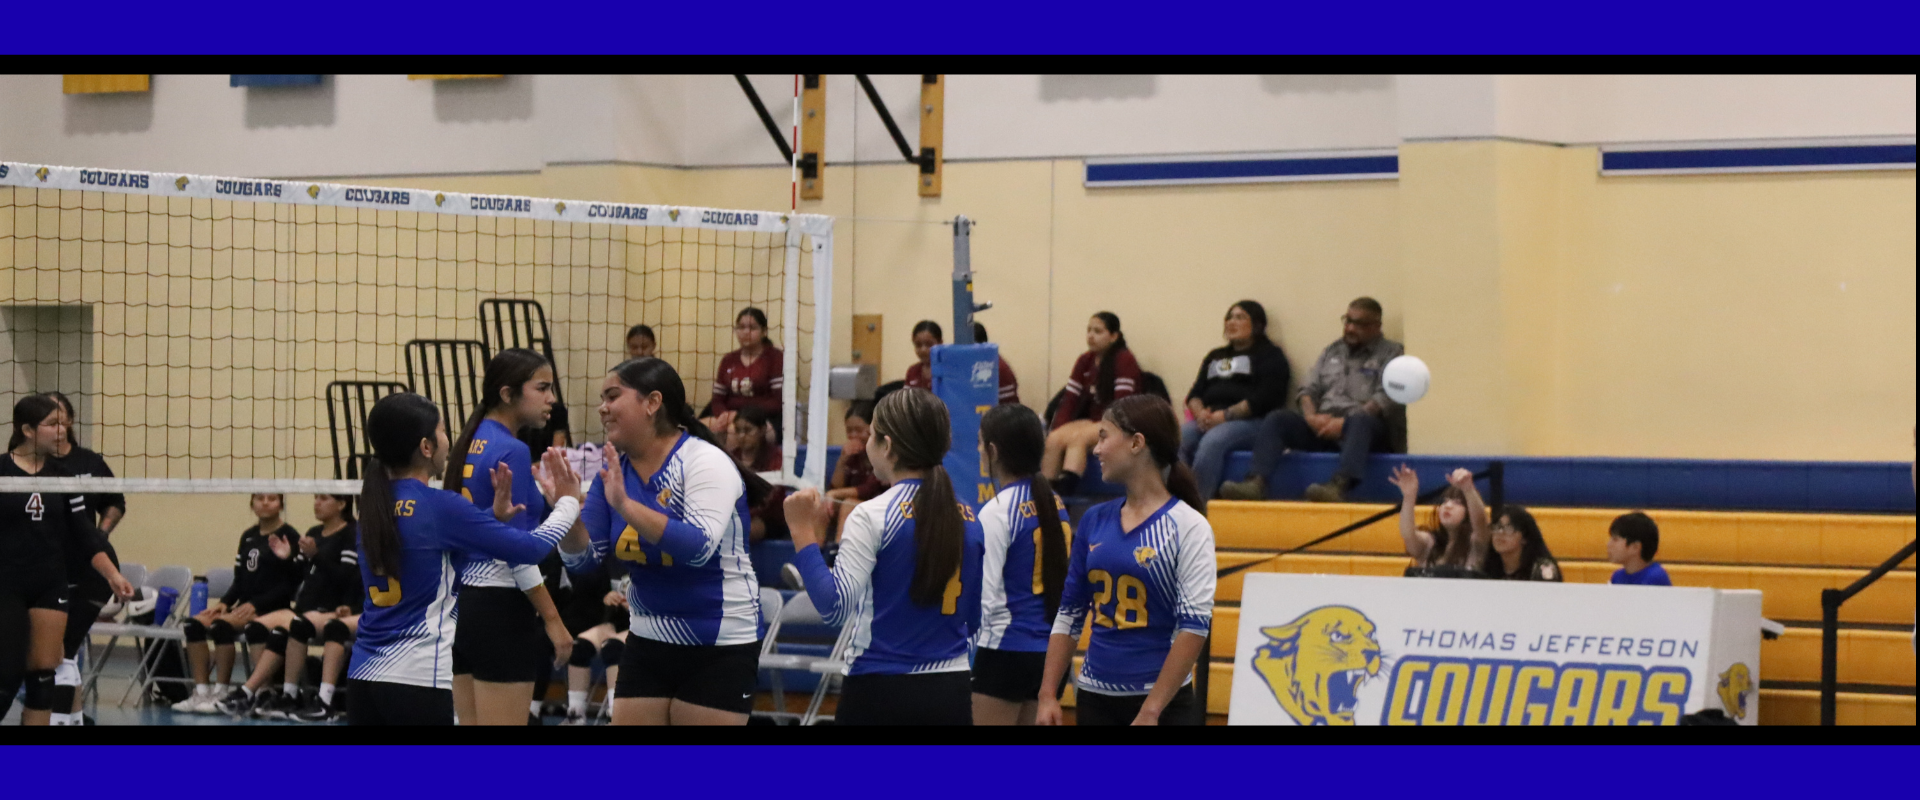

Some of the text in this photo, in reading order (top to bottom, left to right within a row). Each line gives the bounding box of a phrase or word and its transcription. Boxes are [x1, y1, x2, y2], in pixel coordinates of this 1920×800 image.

[80, 169, 149, 188] COUGARS
[216, 179, 282, 197] COUGARS
[345, 188, 410, 205] COUGARS
[470, 196, 531, 212] COUGARS
[588, 204, 648, 220] COUGARS
[701, 210, 759, 226] COUGARS
[25, 493, 44, 520] 4
[246, 548, 260, 572] 3
[1088, 569, 1148, 629] 28
[1402, 629, 1699, 658] THOMAS JEFFERSON
[1385, 657, 1690, 726] COUGARS
